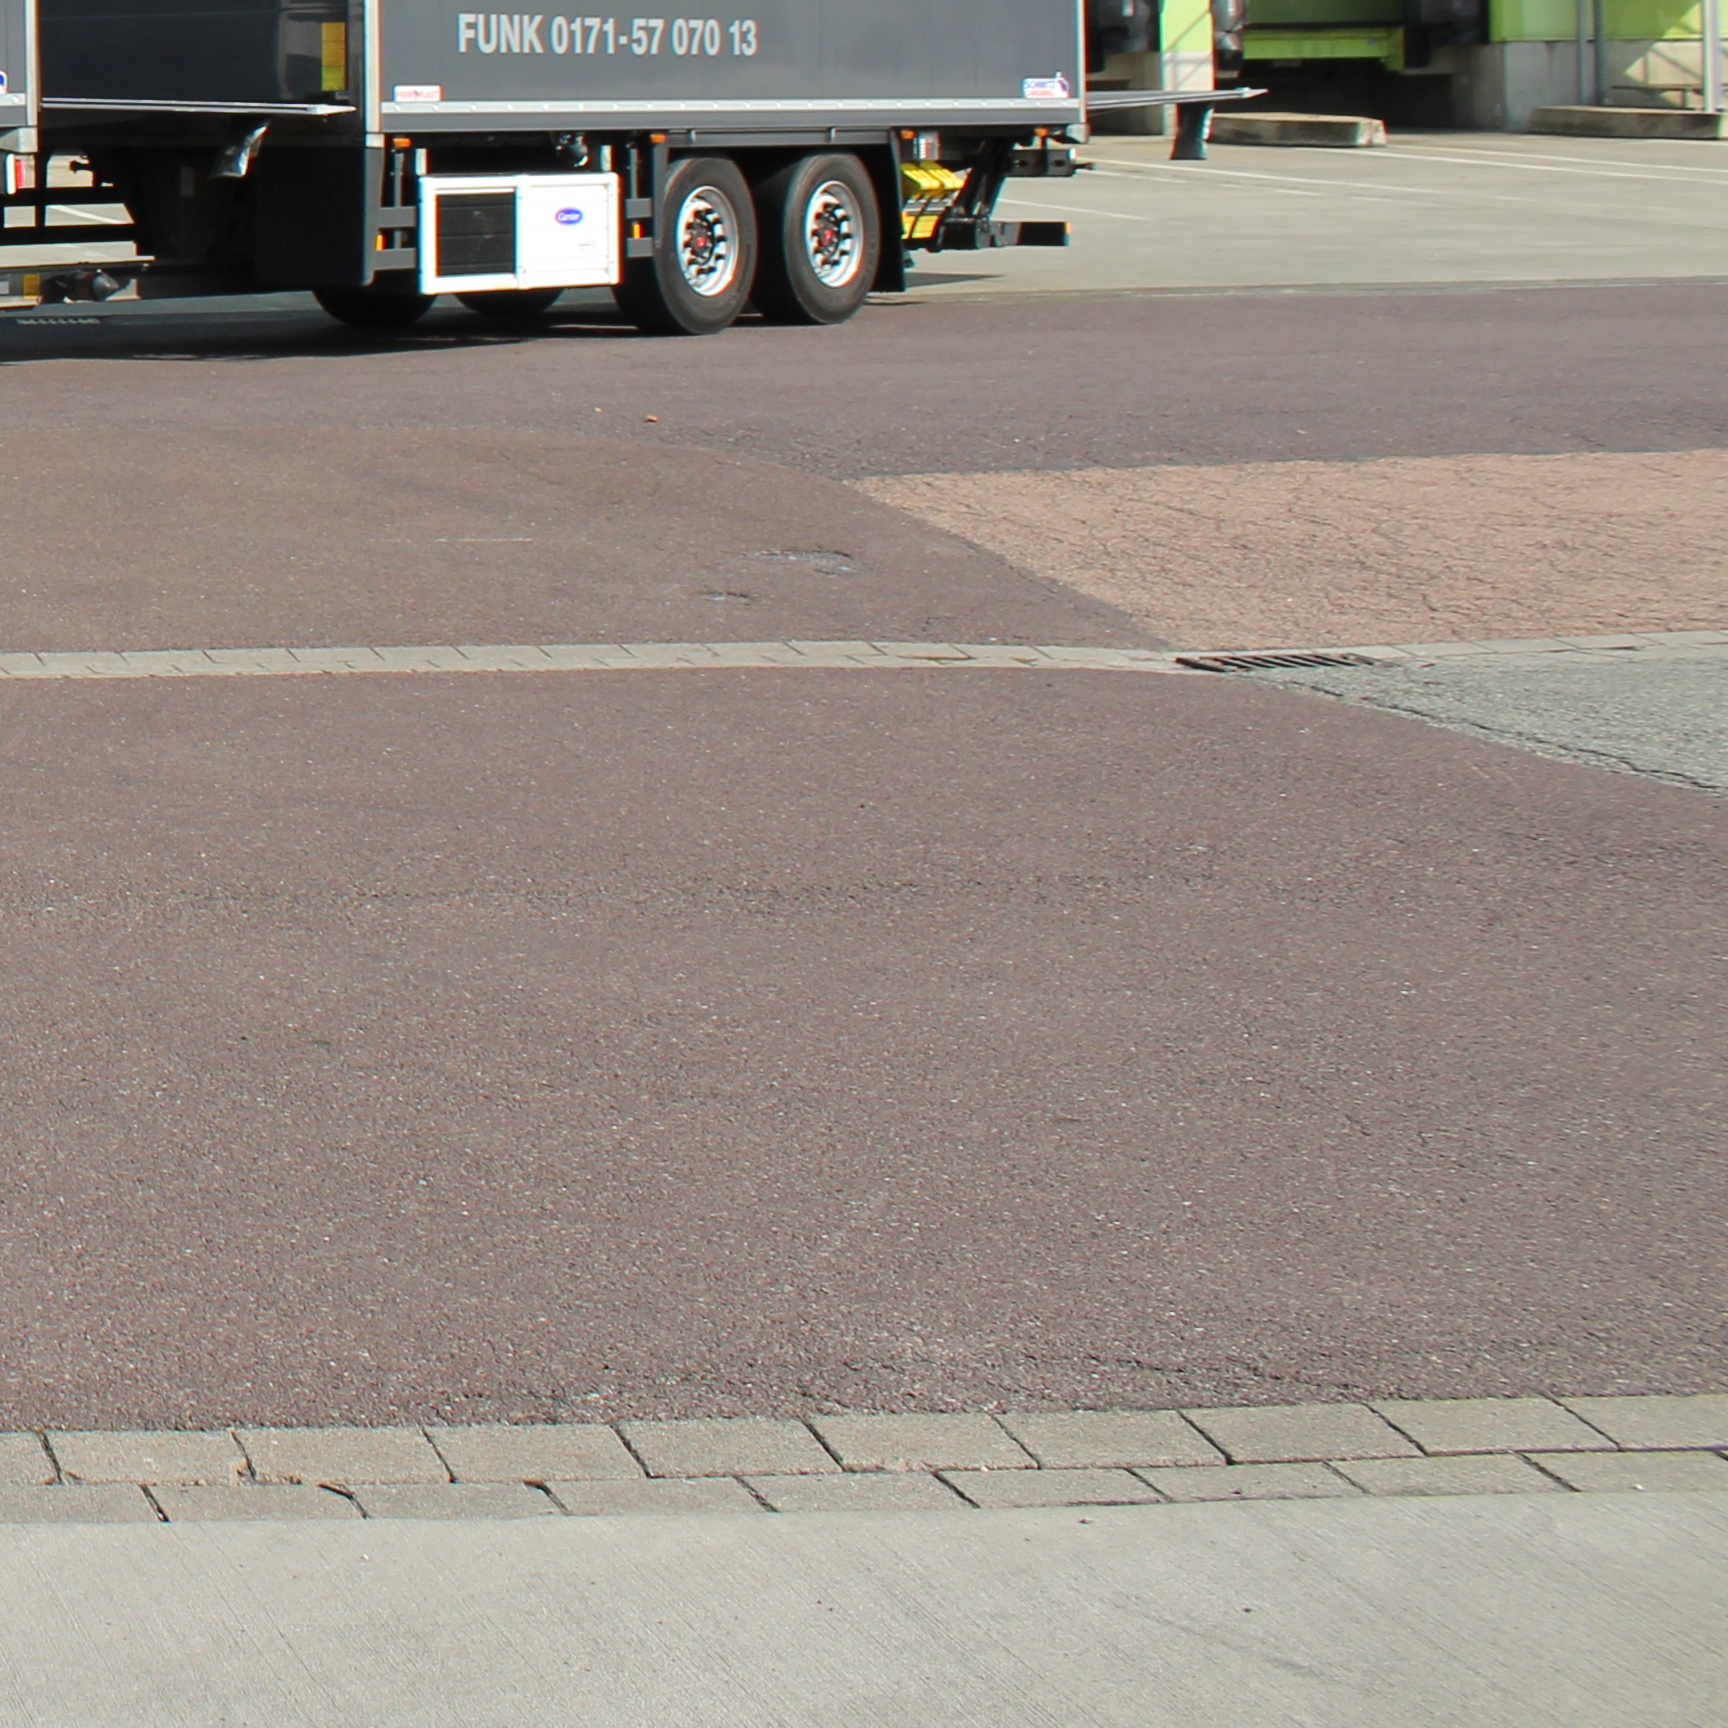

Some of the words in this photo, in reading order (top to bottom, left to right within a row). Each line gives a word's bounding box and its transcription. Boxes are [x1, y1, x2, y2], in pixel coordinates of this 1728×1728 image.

[458, 13, 544, 53] FUNK
[551, 15, 665, 56] 0171-57
[672, 17, 721, 56] 070
[729, 19, 758, 56] 13
